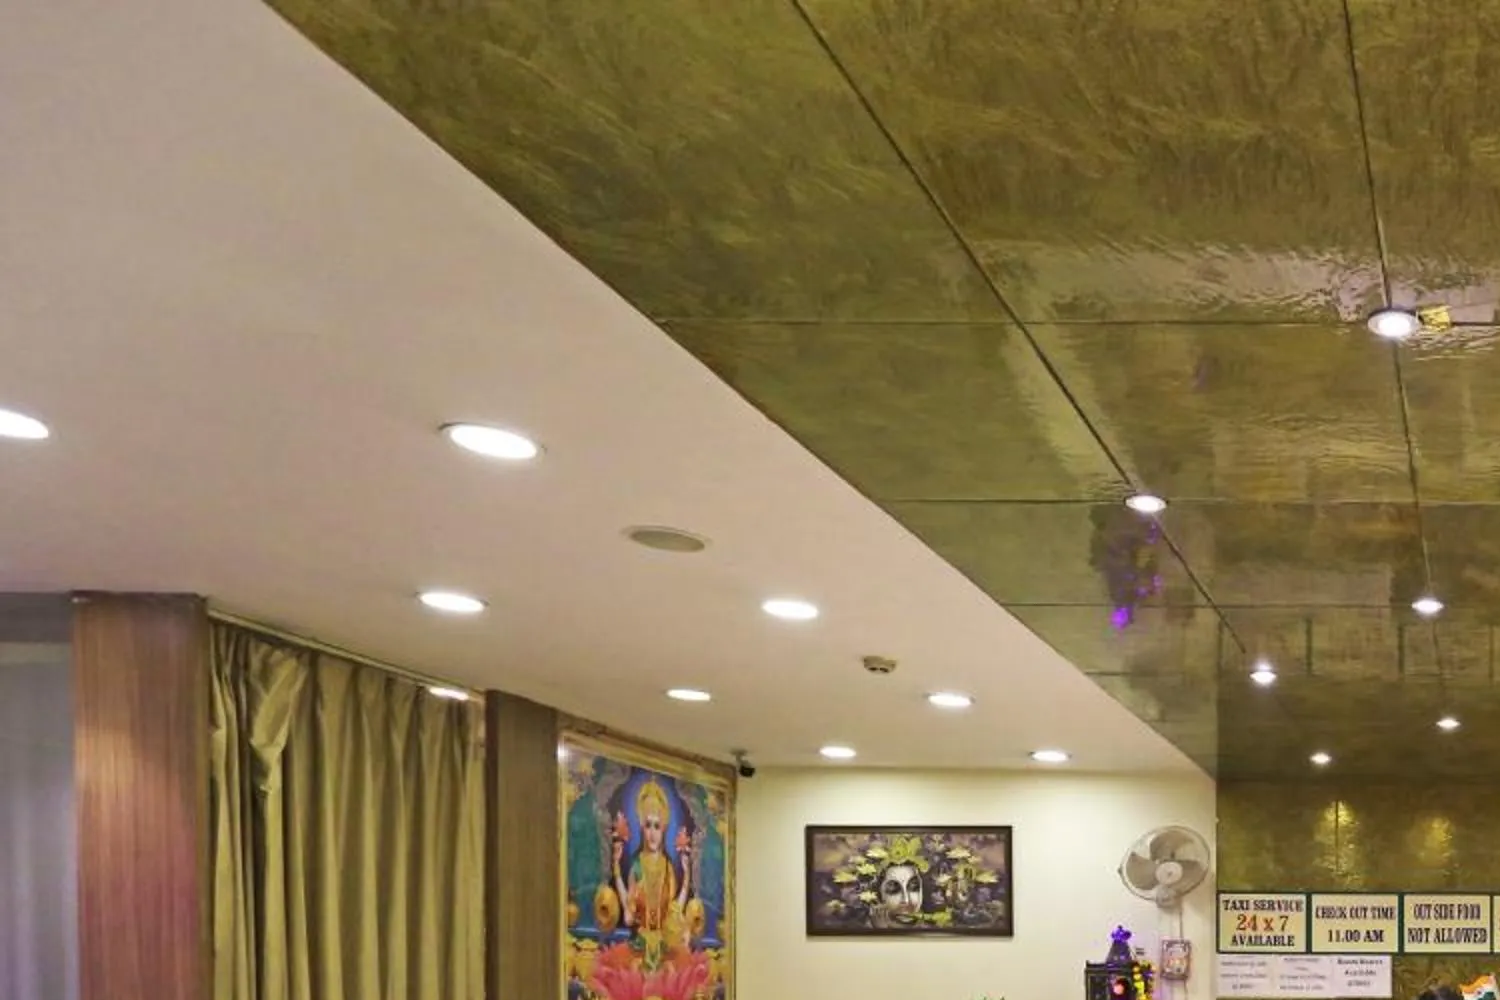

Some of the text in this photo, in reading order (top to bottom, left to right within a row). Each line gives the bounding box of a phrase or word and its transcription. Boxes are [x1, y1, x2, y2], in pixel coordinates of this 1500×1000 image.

[1222, 899, 1304, 912] TAXI SERVICE
[1315, 906, 1395, 919] CHECK OUT TIME
[1457, 903, 1481, 920] FOOD
[1236, 913, 1257, 931] 24
[1279, 914, 1289, 931] 7
[1231, 935, 1295, 947] AVAILABLE
[1328, 929, 1384, 943] 11.00 AM
[1408, 927, 1487, 943] NOT ALLOWED
